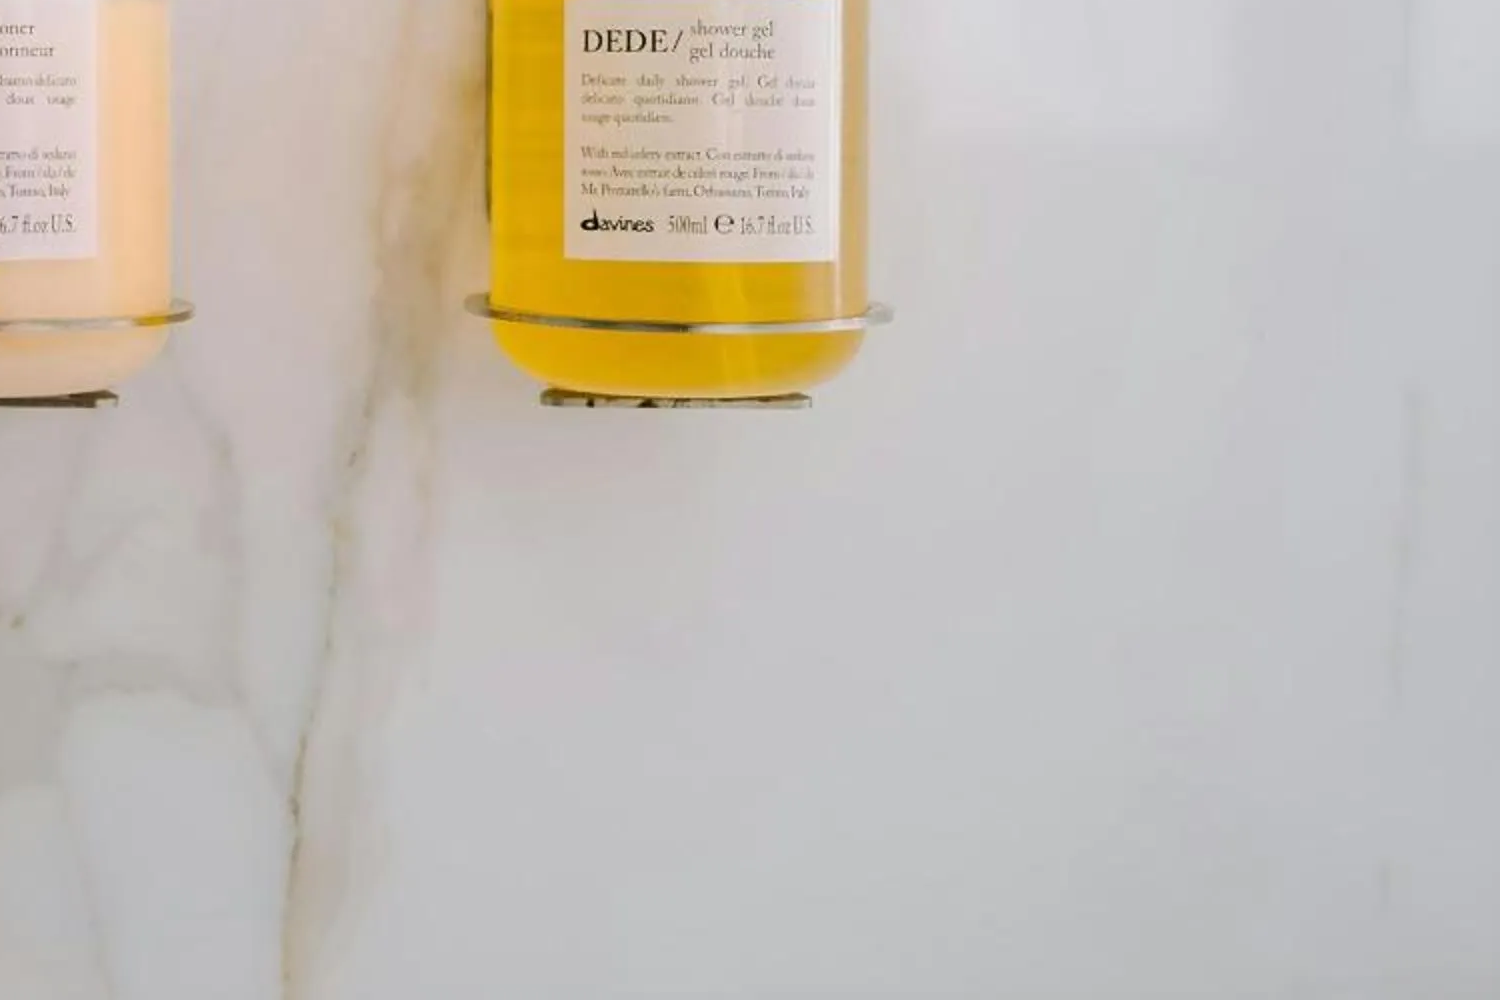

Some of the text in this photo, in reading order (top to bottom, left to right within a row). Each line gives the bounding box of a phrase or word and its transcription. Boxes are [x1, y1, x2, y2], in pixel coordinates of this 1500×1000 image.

[689, 18, 775, 40] shower gel
[689, 42, 776, 64] gel douche
[580, 208, 654, 233] davines
[668, 215, 708, 235] 500ml
